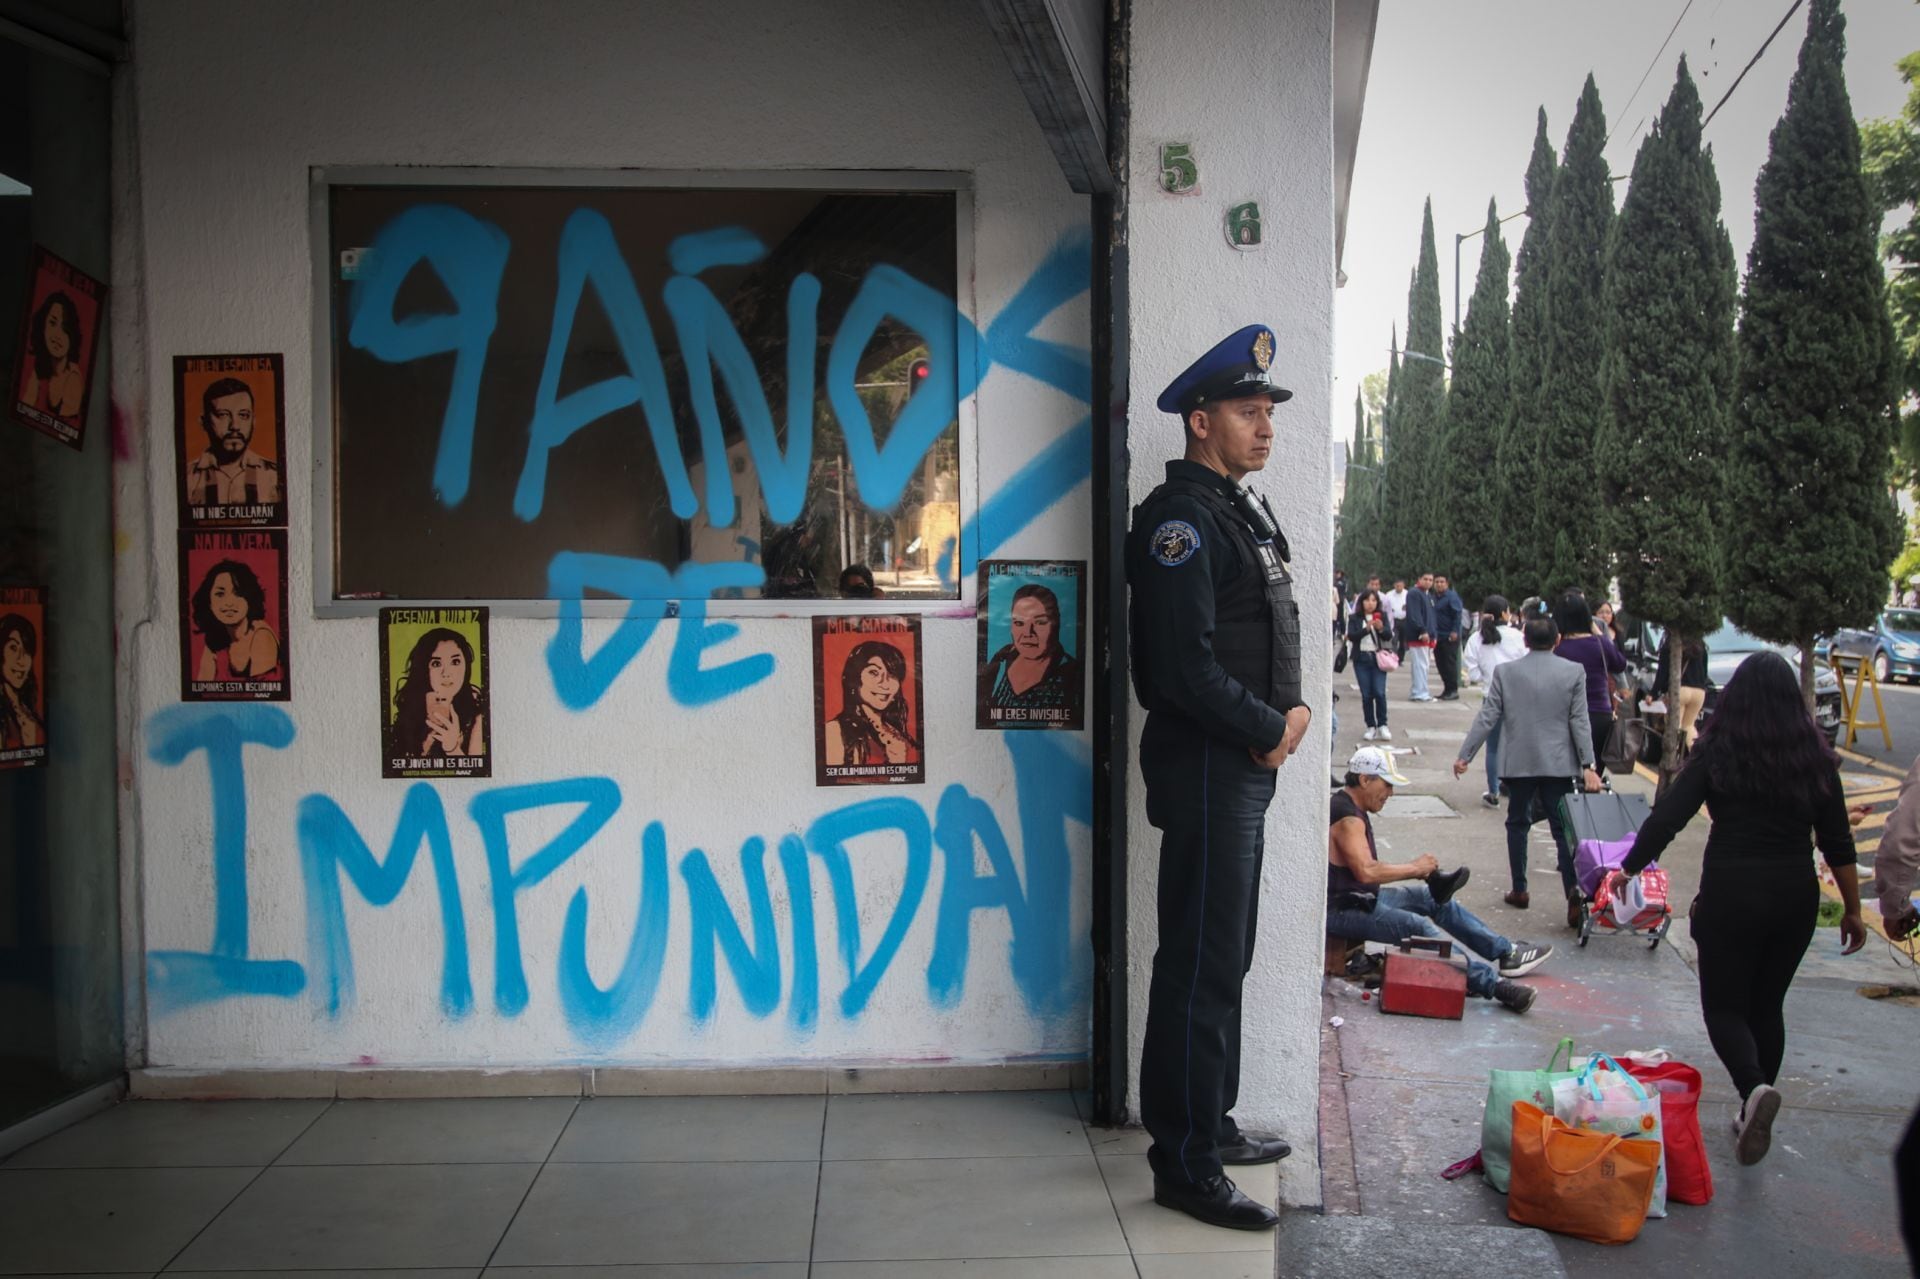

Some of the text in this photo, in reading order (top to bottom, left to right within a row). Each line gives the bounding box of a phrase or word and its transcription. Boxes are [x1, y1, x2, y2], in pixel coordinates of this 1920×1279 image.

[1159, 143, 1198, 195] 5
[1223, 201, 1262, 252] 6
[347, 203, 511, 509] 9
[192, 507, 205, 520] NO
[207, 506, 226, 519] NOS
[239, 533, 272, 550] VERA
[389, 609, 481, 624] YESENIA QUIROZ
[544, 549, 776, 711] DE
[191, 682, 282, 692] ILUMINAS ESTA OSCURIDAD
[990, 708, 1072, 720] NO ERES INVISIBLE
[391, 758, 484, 769] SER JOVEN NO ES DELITO
[826, 765, 918, 777] SER COLOMBIANA NO ES CRIMEN
